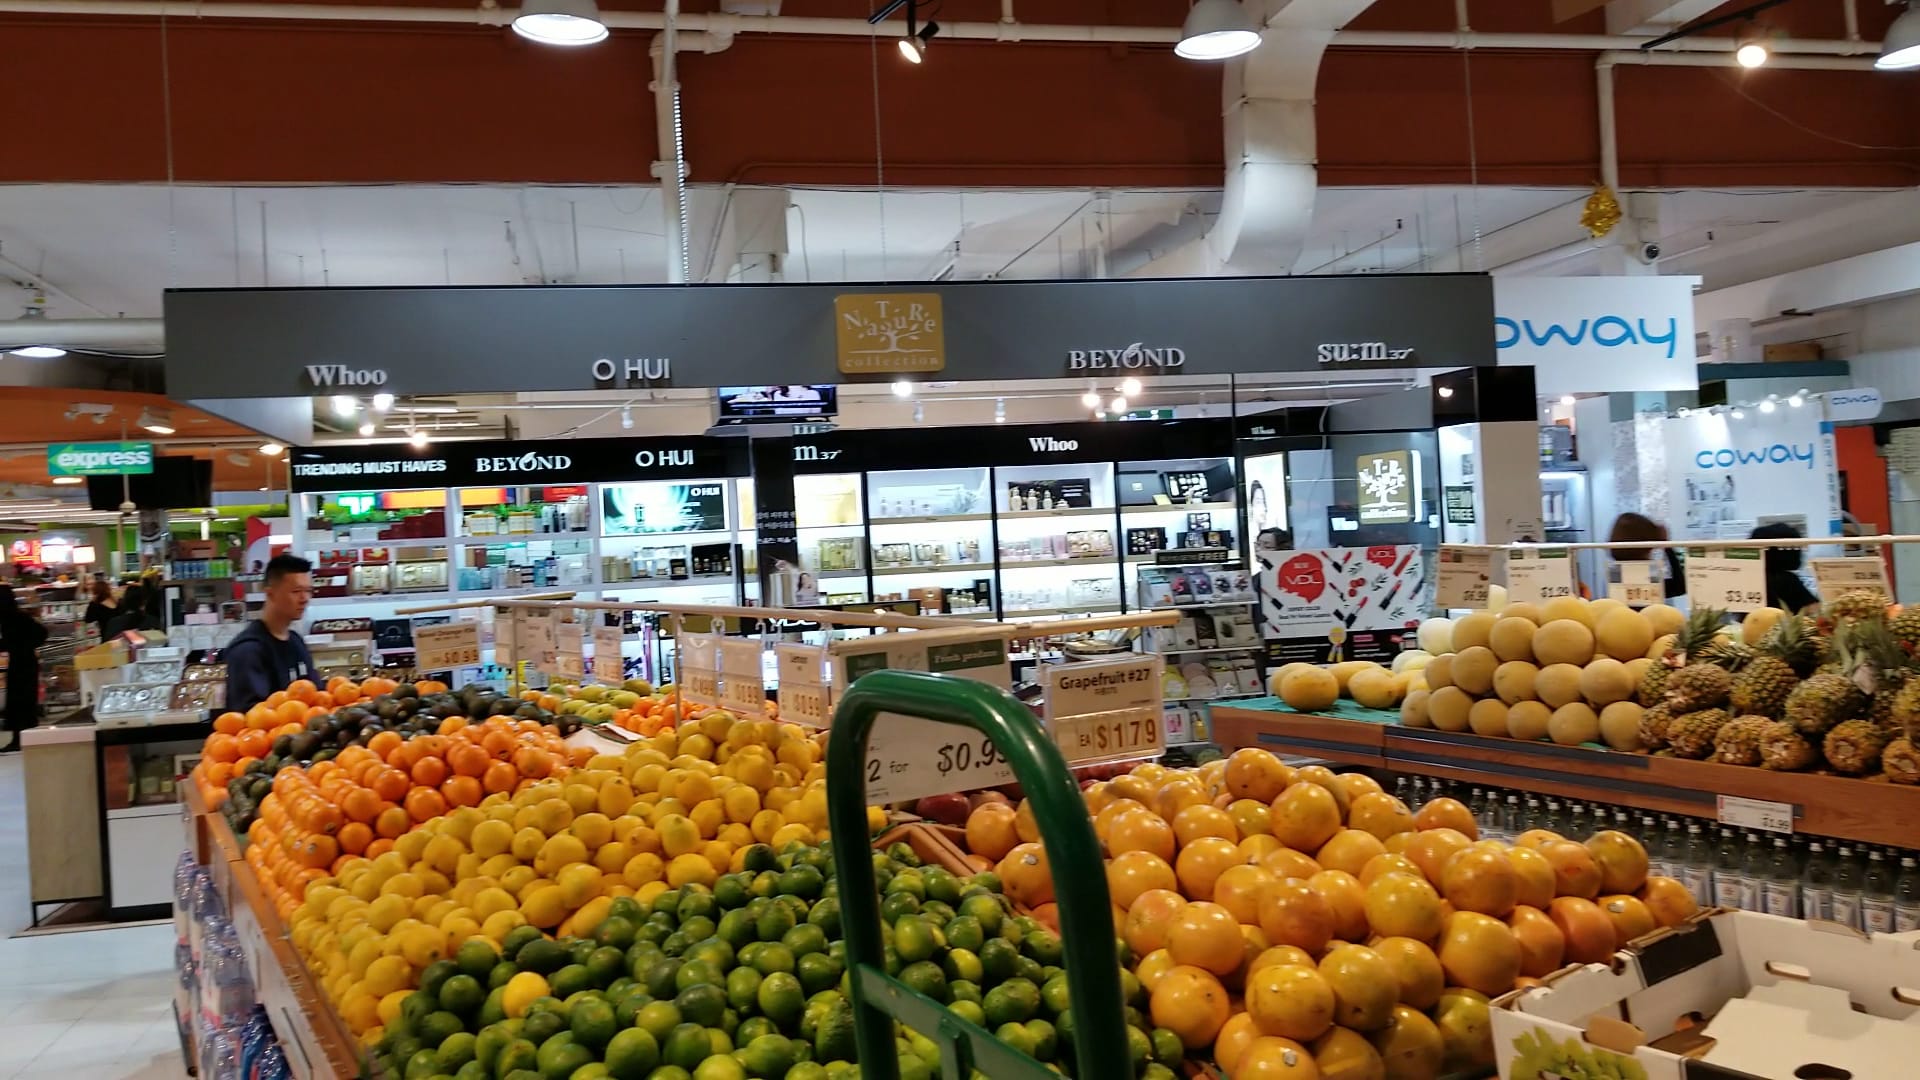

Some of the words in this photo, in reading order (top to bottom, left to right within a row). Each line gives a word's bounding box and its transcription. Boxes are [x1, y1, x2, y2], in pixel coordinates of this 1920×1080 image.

[845, 356, 938, 368] collection
[1068, 343, 1185, 370] BEYOND
[306, 364, 387, 386] Whoo
[592, 358, 615, 380] O
[625, 358, 670, 380] HUI
[1029, 436, 1078, 452] Whoo
[57, 451, 150, 469] express
[476, 451, 571, 472] BEYOND
[635, 450, 656, 468] O
[659, 449, 694, 466] HUI
[1696, 444, 1814, 469] coway
[293, 462, 362, 476] TRENDING
[363, 461, 400, 474] MUST
[402, 460, 447, 473] HAVES
[702, 486, 720, 496] HUI
[1199, 551, 1226, 561] FREE
[1285, 574, 1322, 585] VDL
[1060, 671, 1126, 690] Grapefruit
[1128, 669, 1151, 682] #27
[1080, 734, 1091, 747] EA
[867, 759, 881, 783] 2
[889, 760, 909, 774] for
